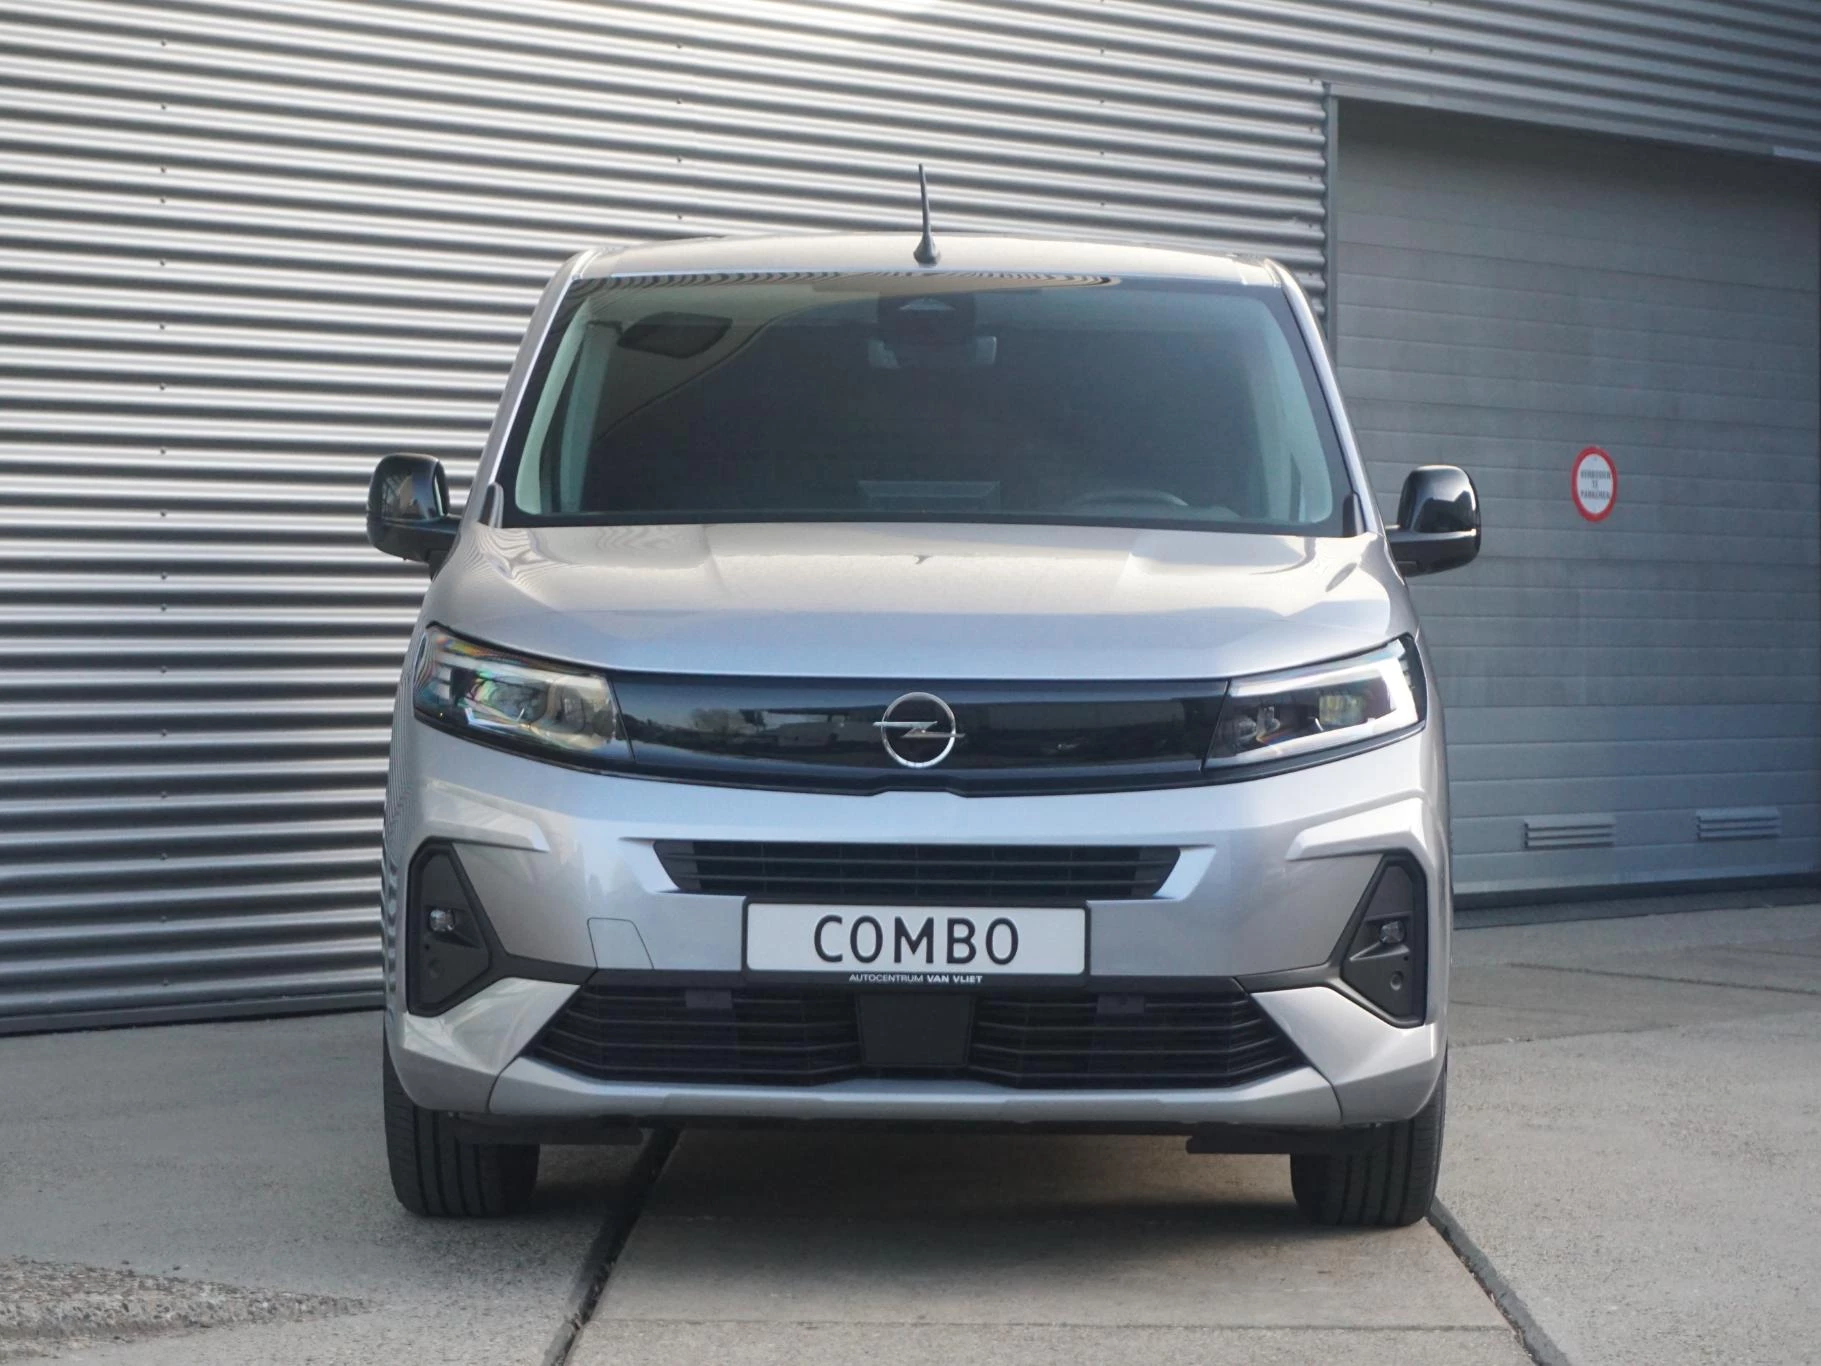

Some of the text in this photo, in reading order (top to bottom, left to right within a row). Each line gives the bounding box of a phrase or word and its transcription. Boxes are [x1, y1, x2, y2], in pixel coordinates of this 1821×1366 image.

[814, 914, 1019, 966] COMBO
[849, 974, 983, 985] AUTOCENTRUM VAN VLIET
